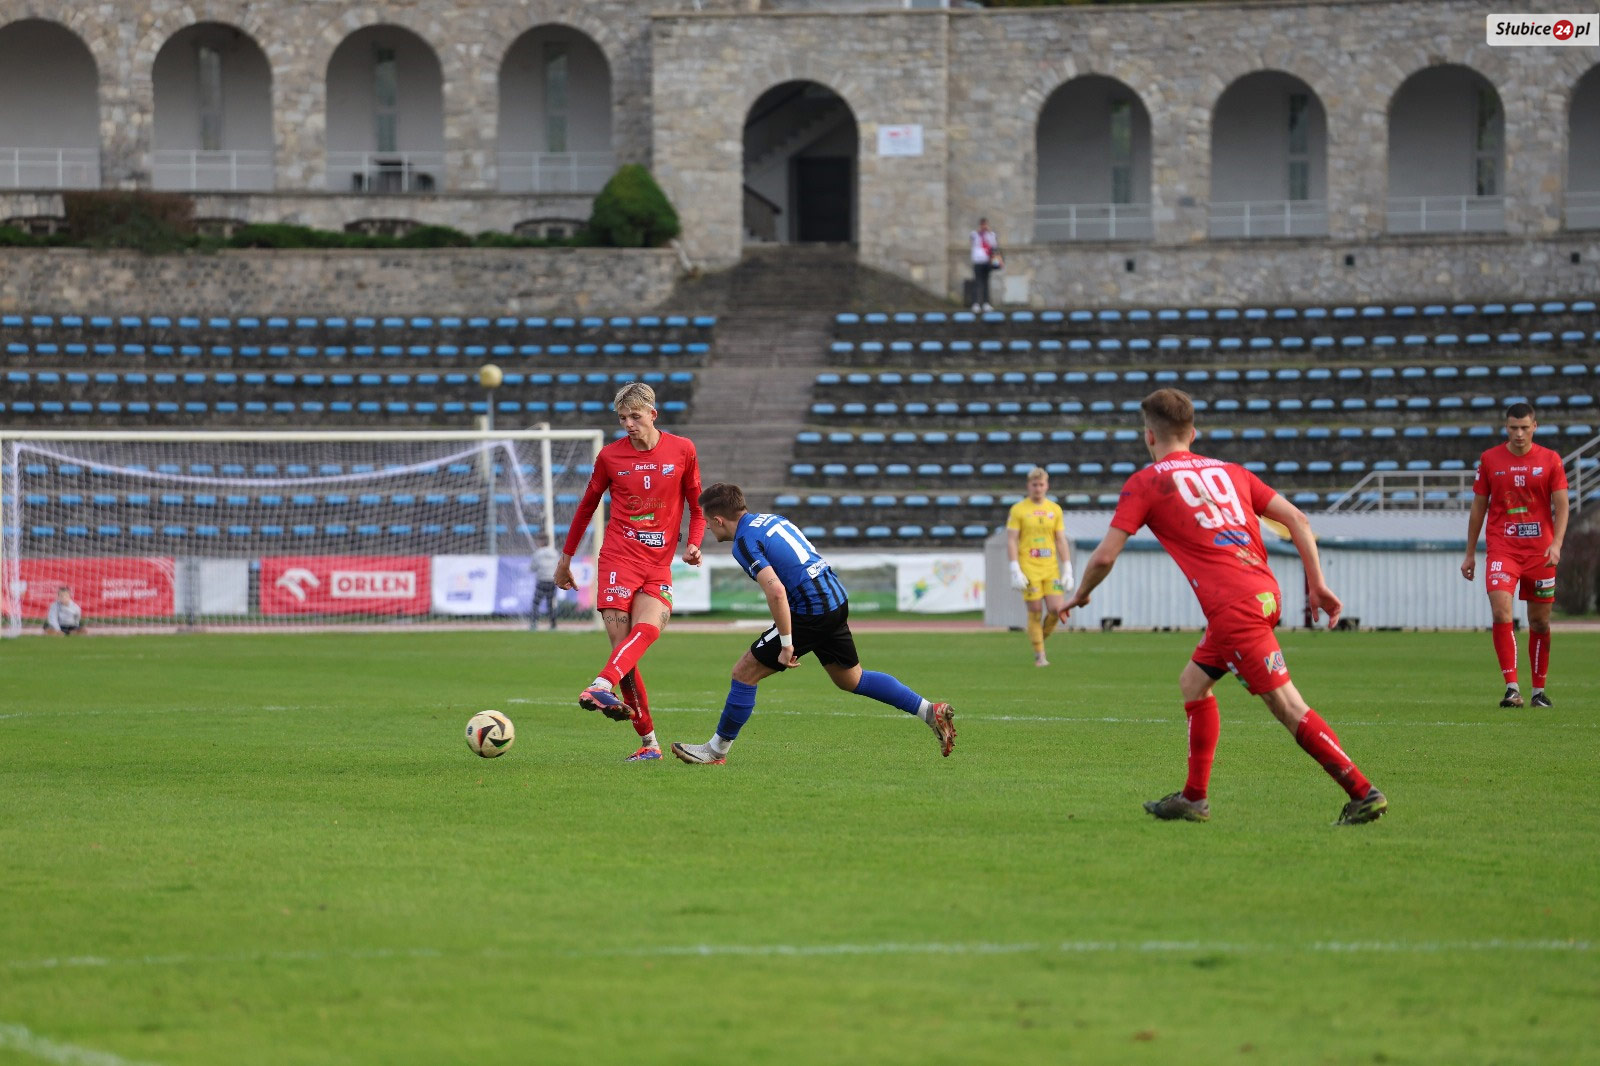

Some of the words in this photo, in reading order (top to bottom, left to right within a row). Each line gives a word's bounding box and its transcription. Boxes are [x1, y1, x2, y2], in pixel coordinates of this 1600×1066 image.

[643, 475, 651, 490] 8
[1172, 467, 1246, 529] 99
[338, 576, 409, 592] ORLEN
[609, 571, 617, 585] 8
